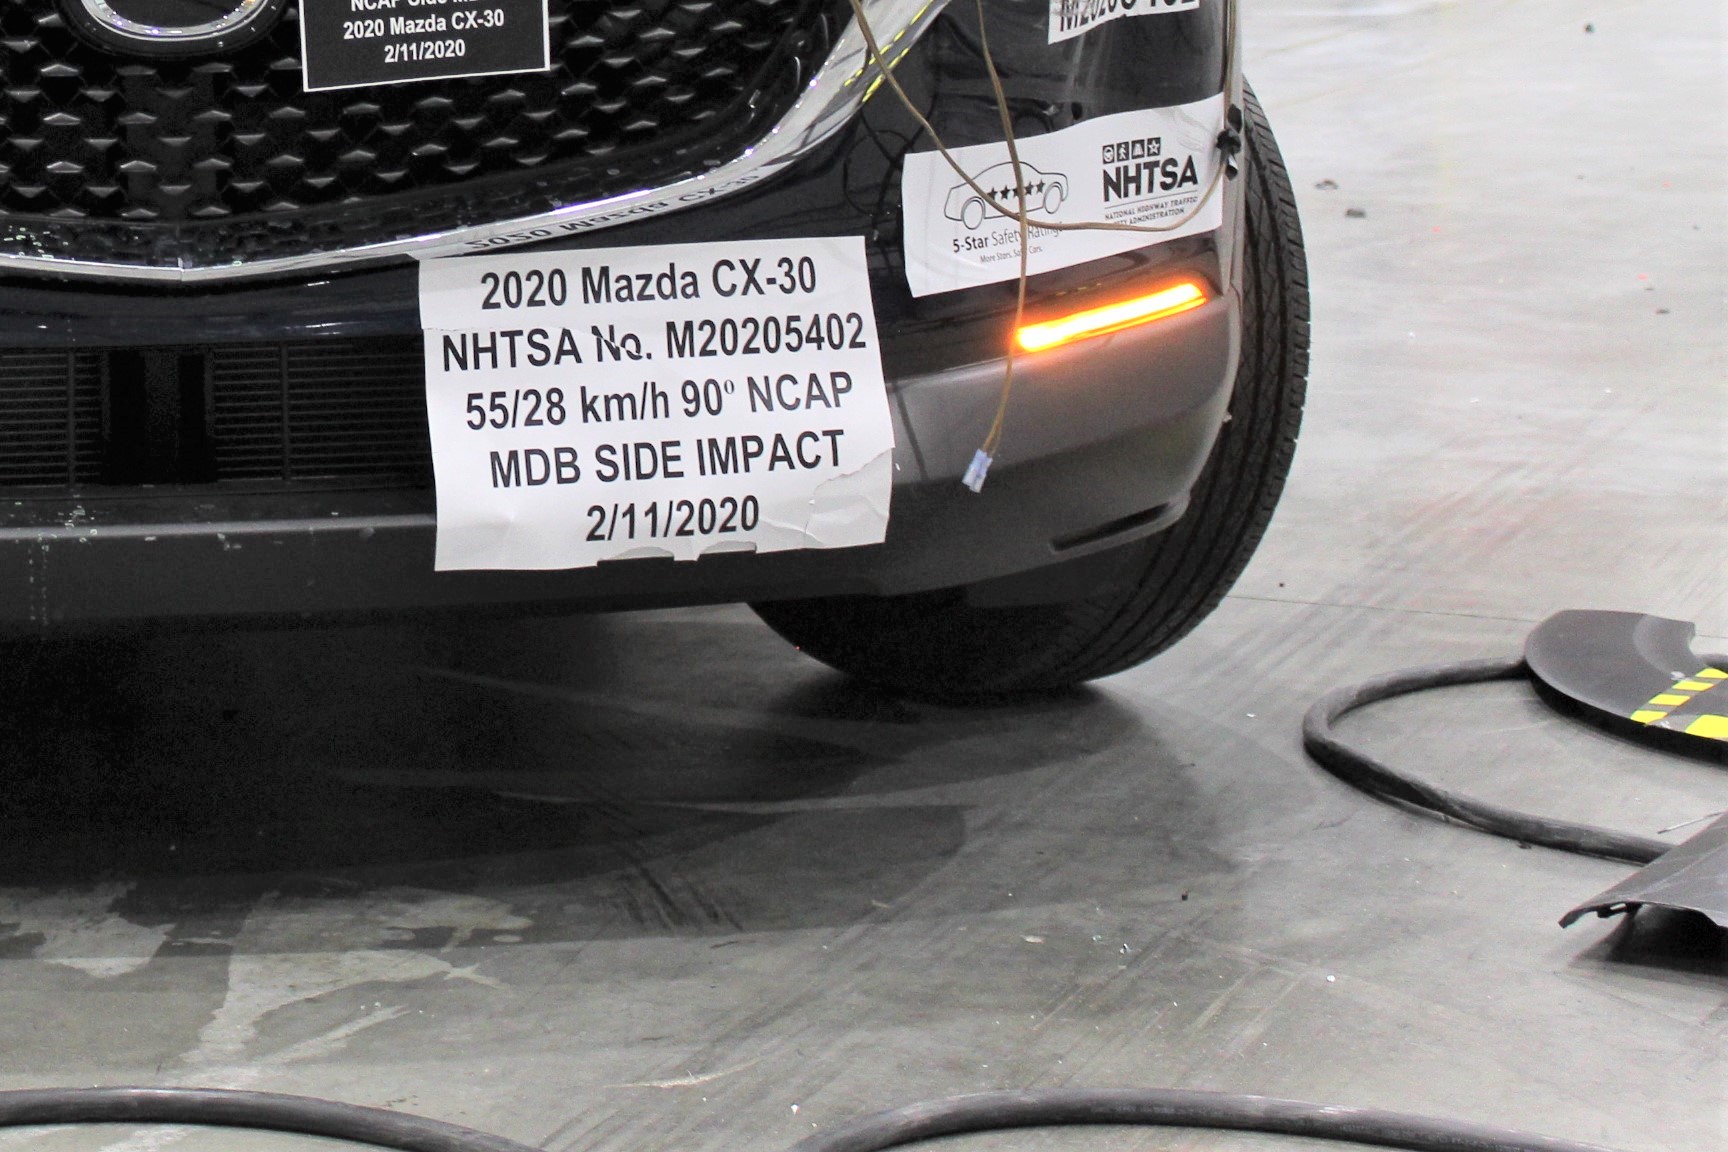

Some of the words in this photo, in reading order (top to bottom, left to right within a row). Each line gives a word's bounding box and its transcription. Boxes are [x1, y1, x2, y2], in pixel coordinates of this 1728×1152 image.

[343, 19, 385, 40] 2020
[389, 14, 447, 35] Mazda
[451, 9, 505, 30] CX-30
[383, 39, 466, 63] 2/11/2020
[1103, 154, 1198, 202] NHTSA
[1105, 209, 1136, 221] NATIONAL
[1137, 201, 1169, 213] HIGHWAY
[1170, 196, 1198, 207] TRAFFIC
[1129, 208, 1185, 225] ADMINISTRATION
[953, 235, 989, 253] 5-Star
[980, 253, 996, 264] More
[481, 268, 568, 310] 2020
[581, 262, 700, 305] Mazda
[712, 255, 816, 298] CX-30
[442, 327, 582, 372] NHTSA
[591, 324, 653, 362] No.
[666, 312, 867, 359] M20205402
[466, 387, 566, 431] 55/28
[580, 380, 670, 424] km/h
[747, 371, 853, 413] NCAP
[490, 446, 581, 489] MDB
[595, 439, 685, 483] SIDE
[696, 429, 845, 477] IMPACT
[586, 495, 759, 542] 2/11/2020
